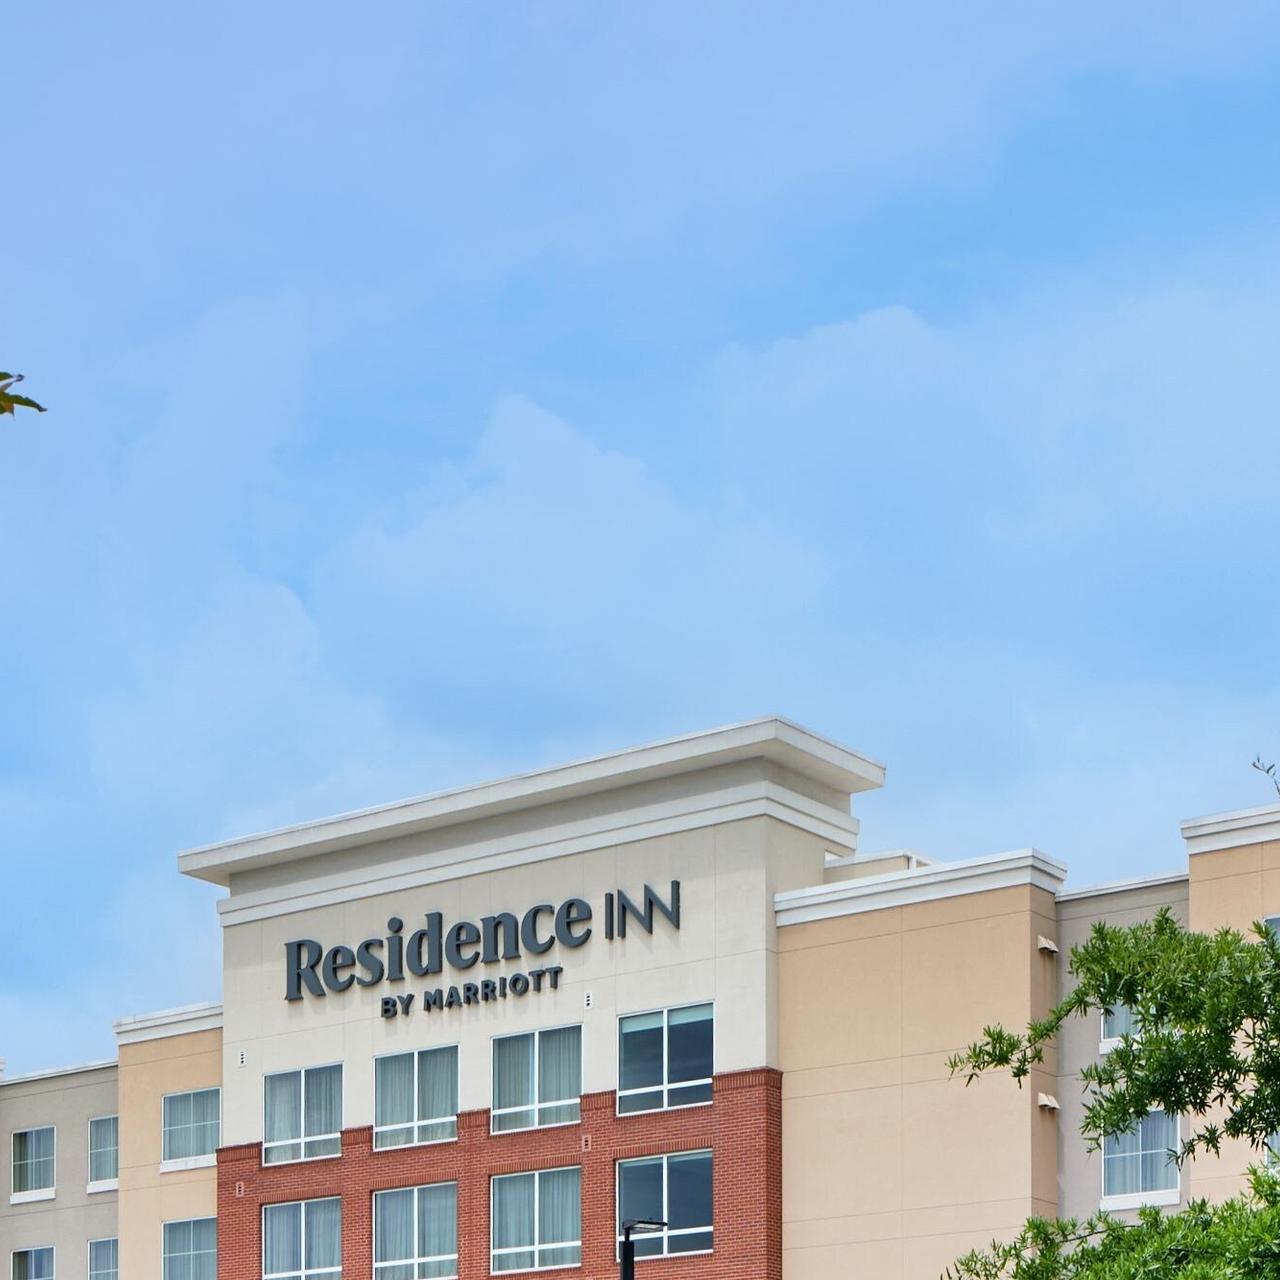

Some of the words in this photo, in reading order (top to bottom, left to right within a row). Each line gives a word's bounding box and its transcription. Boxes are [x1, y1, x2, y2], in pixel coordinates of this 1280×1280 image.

[284, 898, 593, 1002] Residence
[604, 879, 681, 940] INN
[381, 993, 415, 1019] BY
[423, 966, 564, 1012] MARRIOTT
